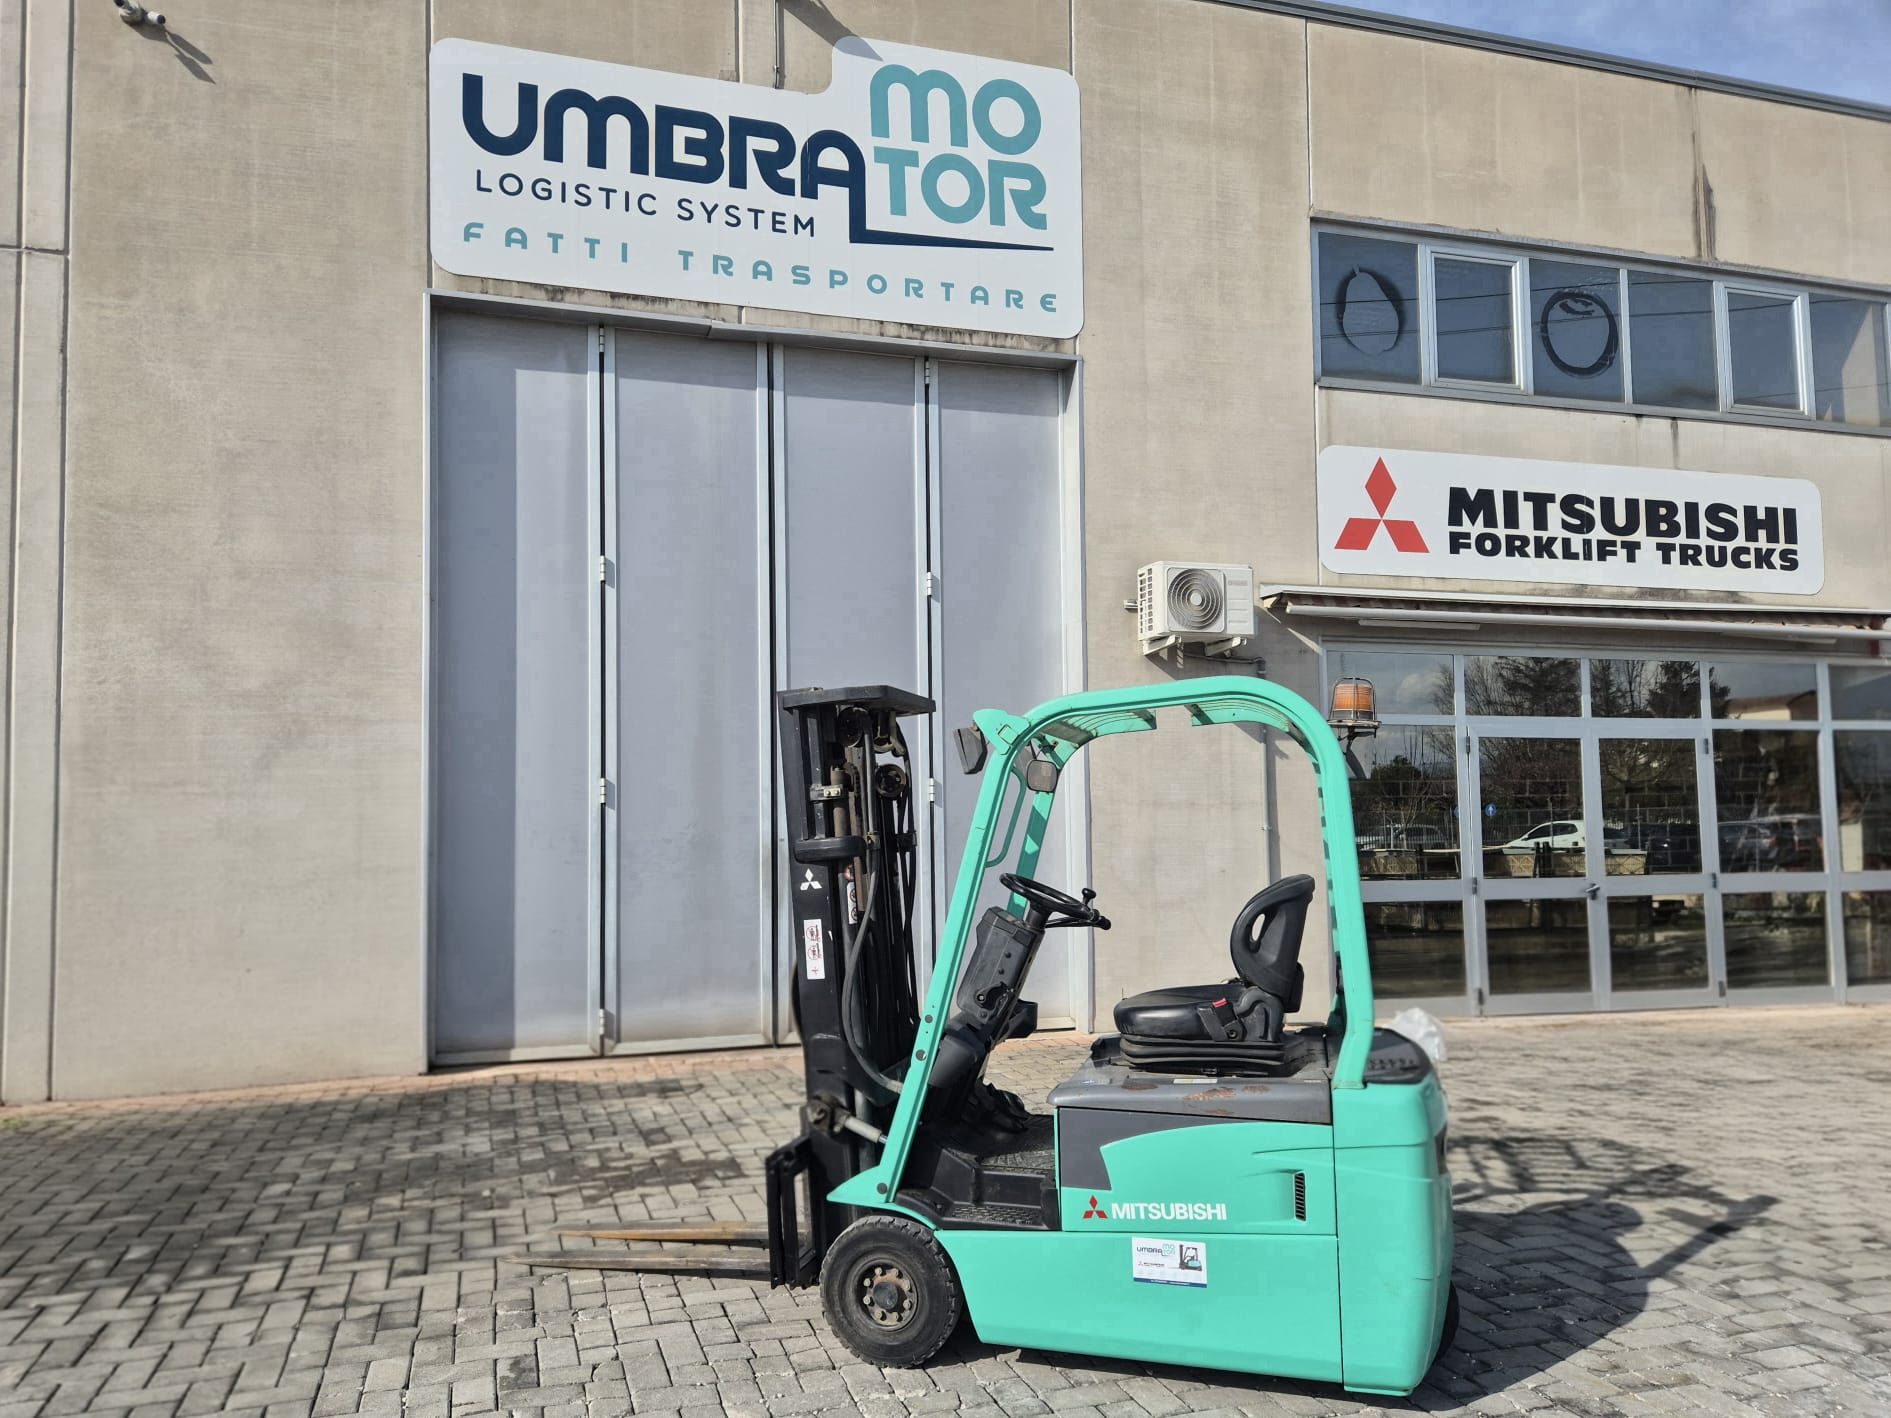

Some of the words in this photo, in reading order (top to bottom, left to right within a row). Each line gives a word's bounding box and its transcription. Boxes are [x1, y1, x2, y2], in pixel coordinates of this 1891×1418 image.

[869, 63, 1042, 156] MO
[462, 72, 867, 243] UMBRA
[873, 145, 1048, 231] TOR
[475, 168, 658, 217] LOGISTIC
[676, 197, 816, 239] SYSTEM
[463, 221, 629, 264] FATTI
[677, 249, 1058, 314] TRASPORTARE
[1447, 486, 1799, 546] MITSUBISHI
[1448, 530, 1642, 564] FORKLIFT
[1655, 542, 1800, 573] TRUCKS
[1111, 1202, 1228, 1221] MITSUBISHI
